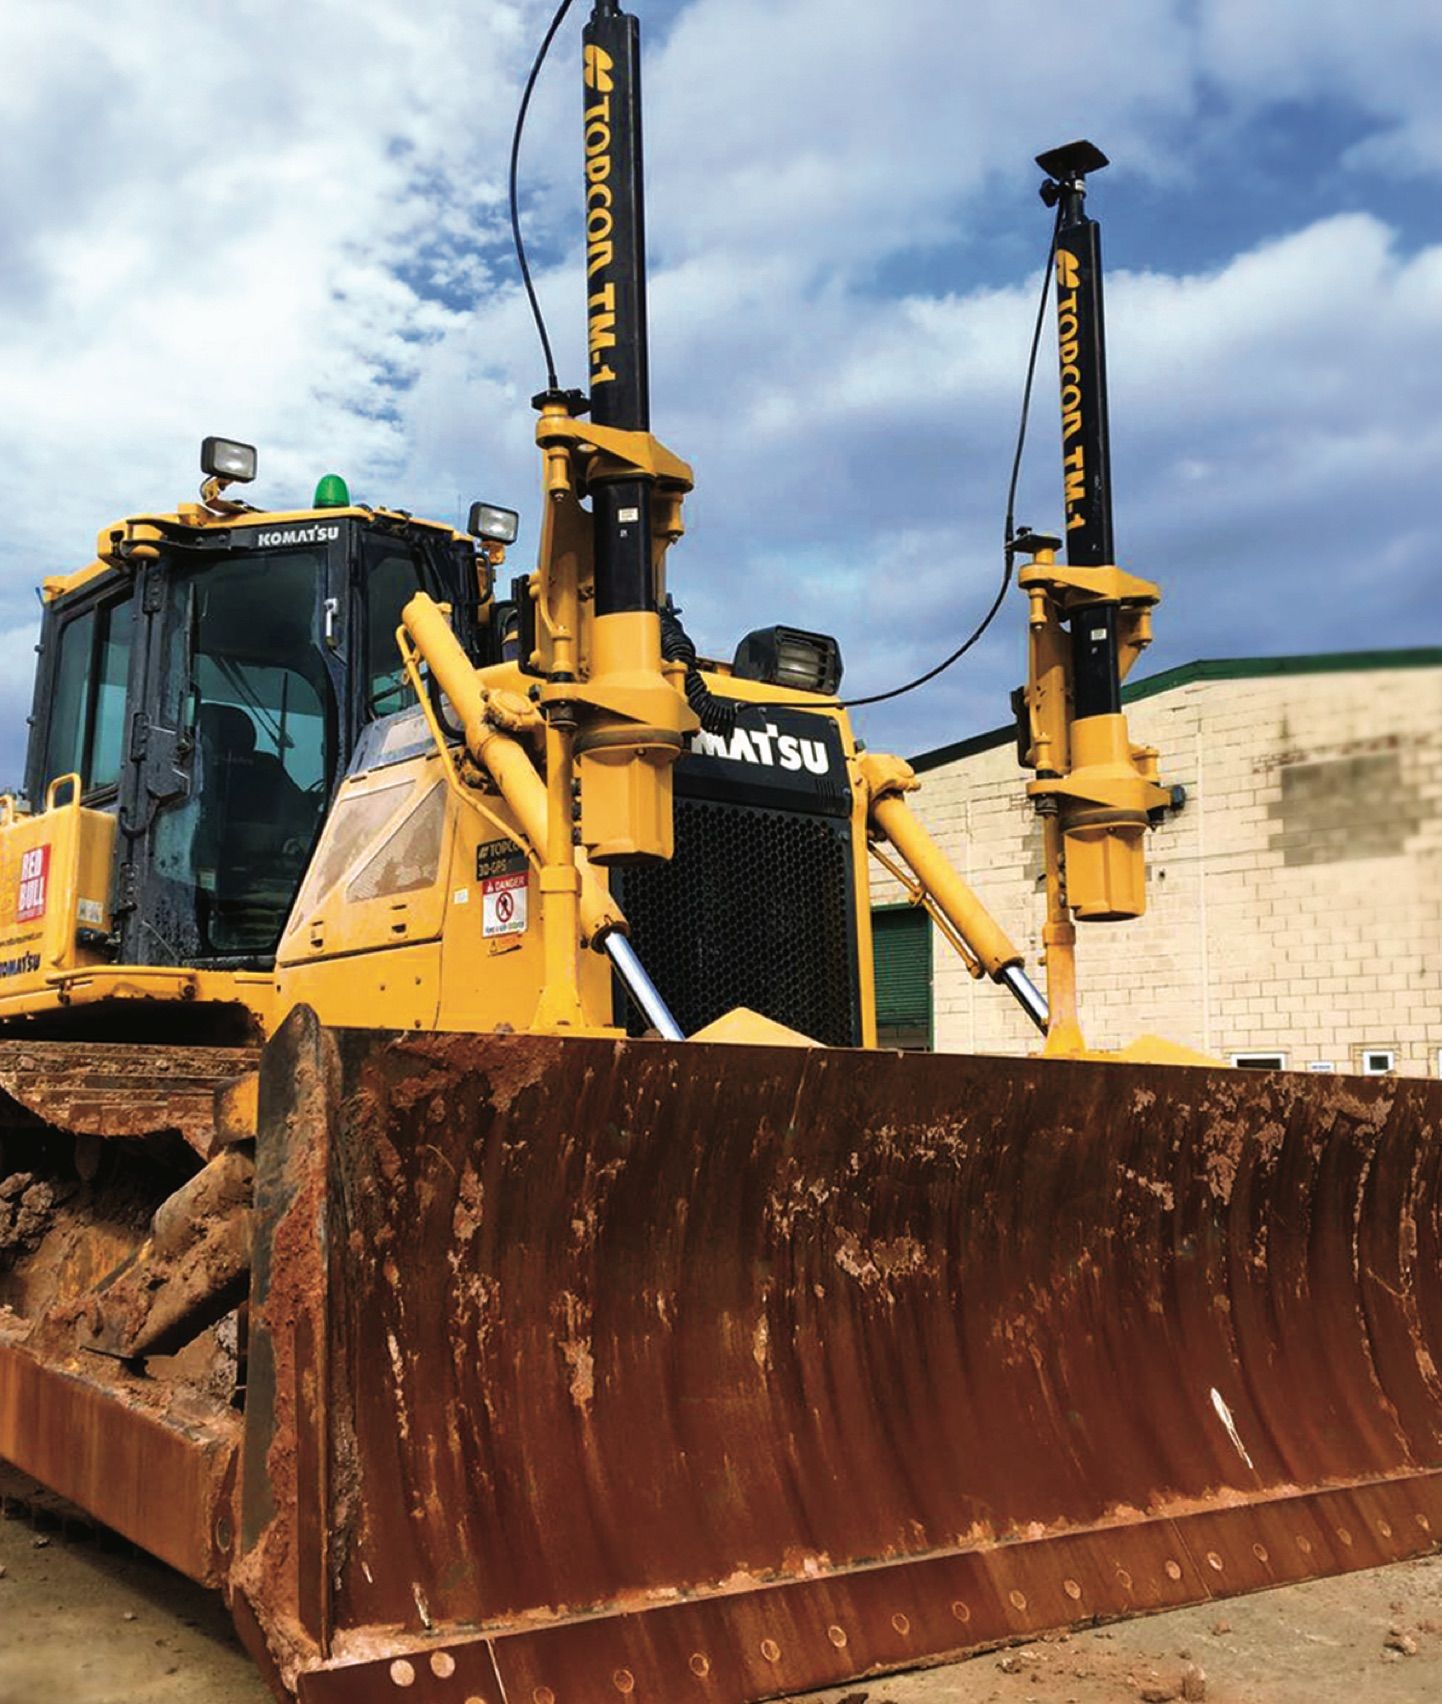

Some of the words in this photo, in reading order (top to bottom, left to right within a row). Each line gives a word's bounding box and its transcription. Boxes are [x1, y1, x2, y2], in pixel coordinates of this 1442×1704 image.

[584, 95, 613, 278] TOPCON
[588, 282, 616, 385] TM-1
[1058, 289, 1082, 440] TOPCON
[1063, 445, 1086, 531] TM-1
[258, 525, 339, 547] KOMATSU
[691, 723, 829, 776] MATSU
[495, 875, 525, 891] DANGER
[0, 950, 41, 978] OMATSU
